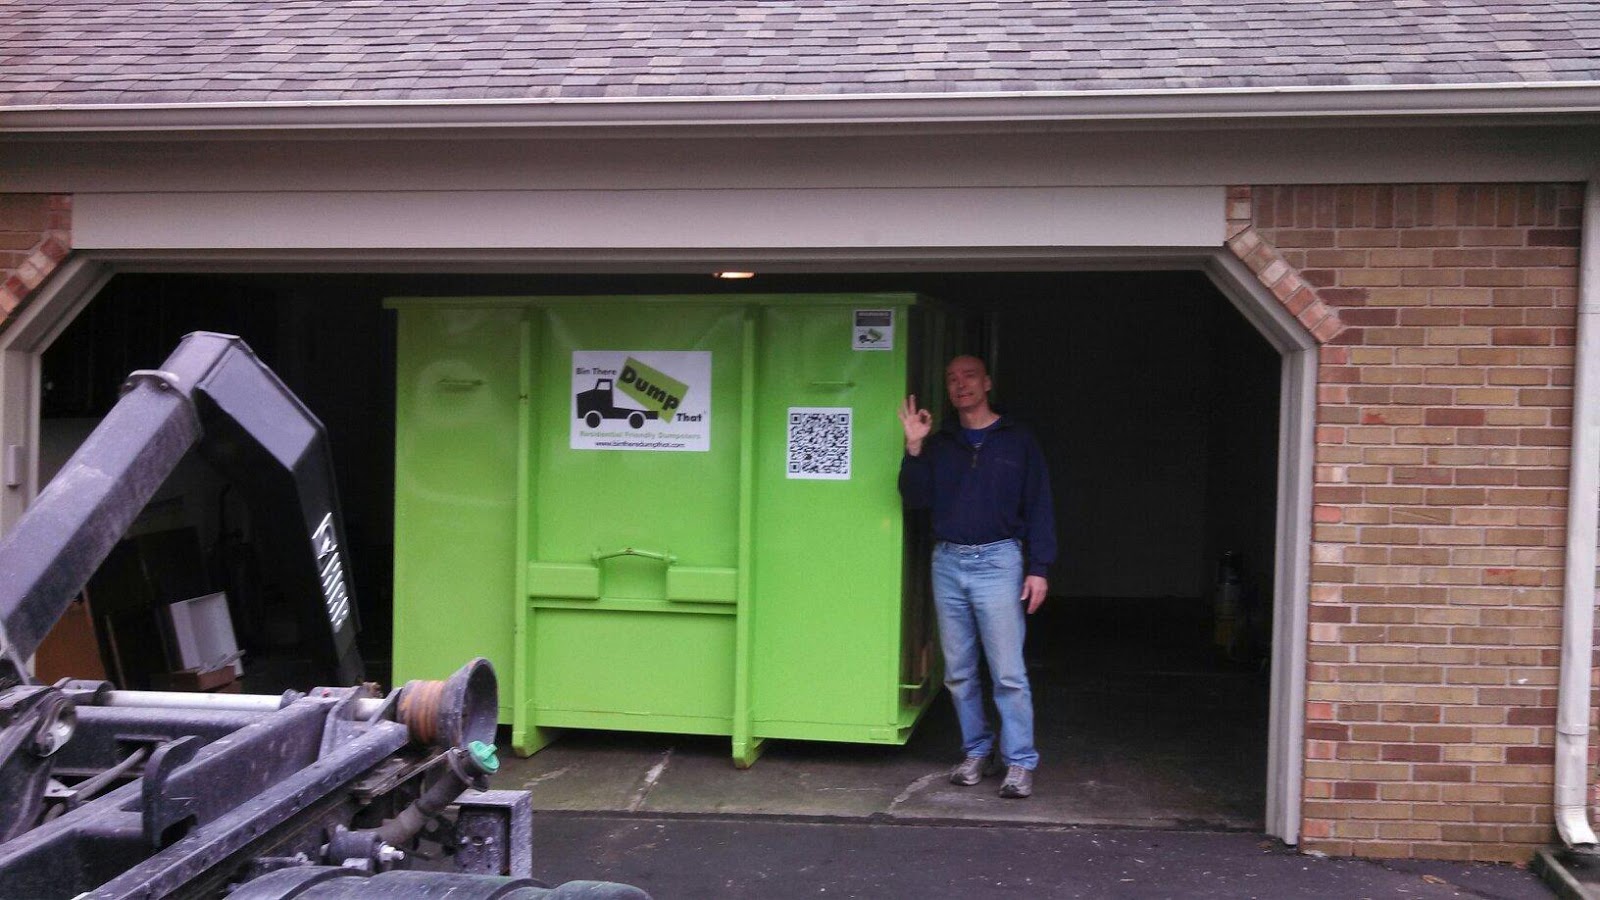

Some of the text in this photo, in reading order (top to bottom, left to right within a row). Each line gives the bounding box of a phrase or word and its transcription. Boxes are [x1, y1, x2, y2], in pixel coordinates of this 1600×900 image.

[576, 367, 617, 376] Bin There
[619, 365, 680, 411] Dump
[676, 413, 703, 422] That
[580, 430, 701, 440] Residential Friendly Dumpsters
